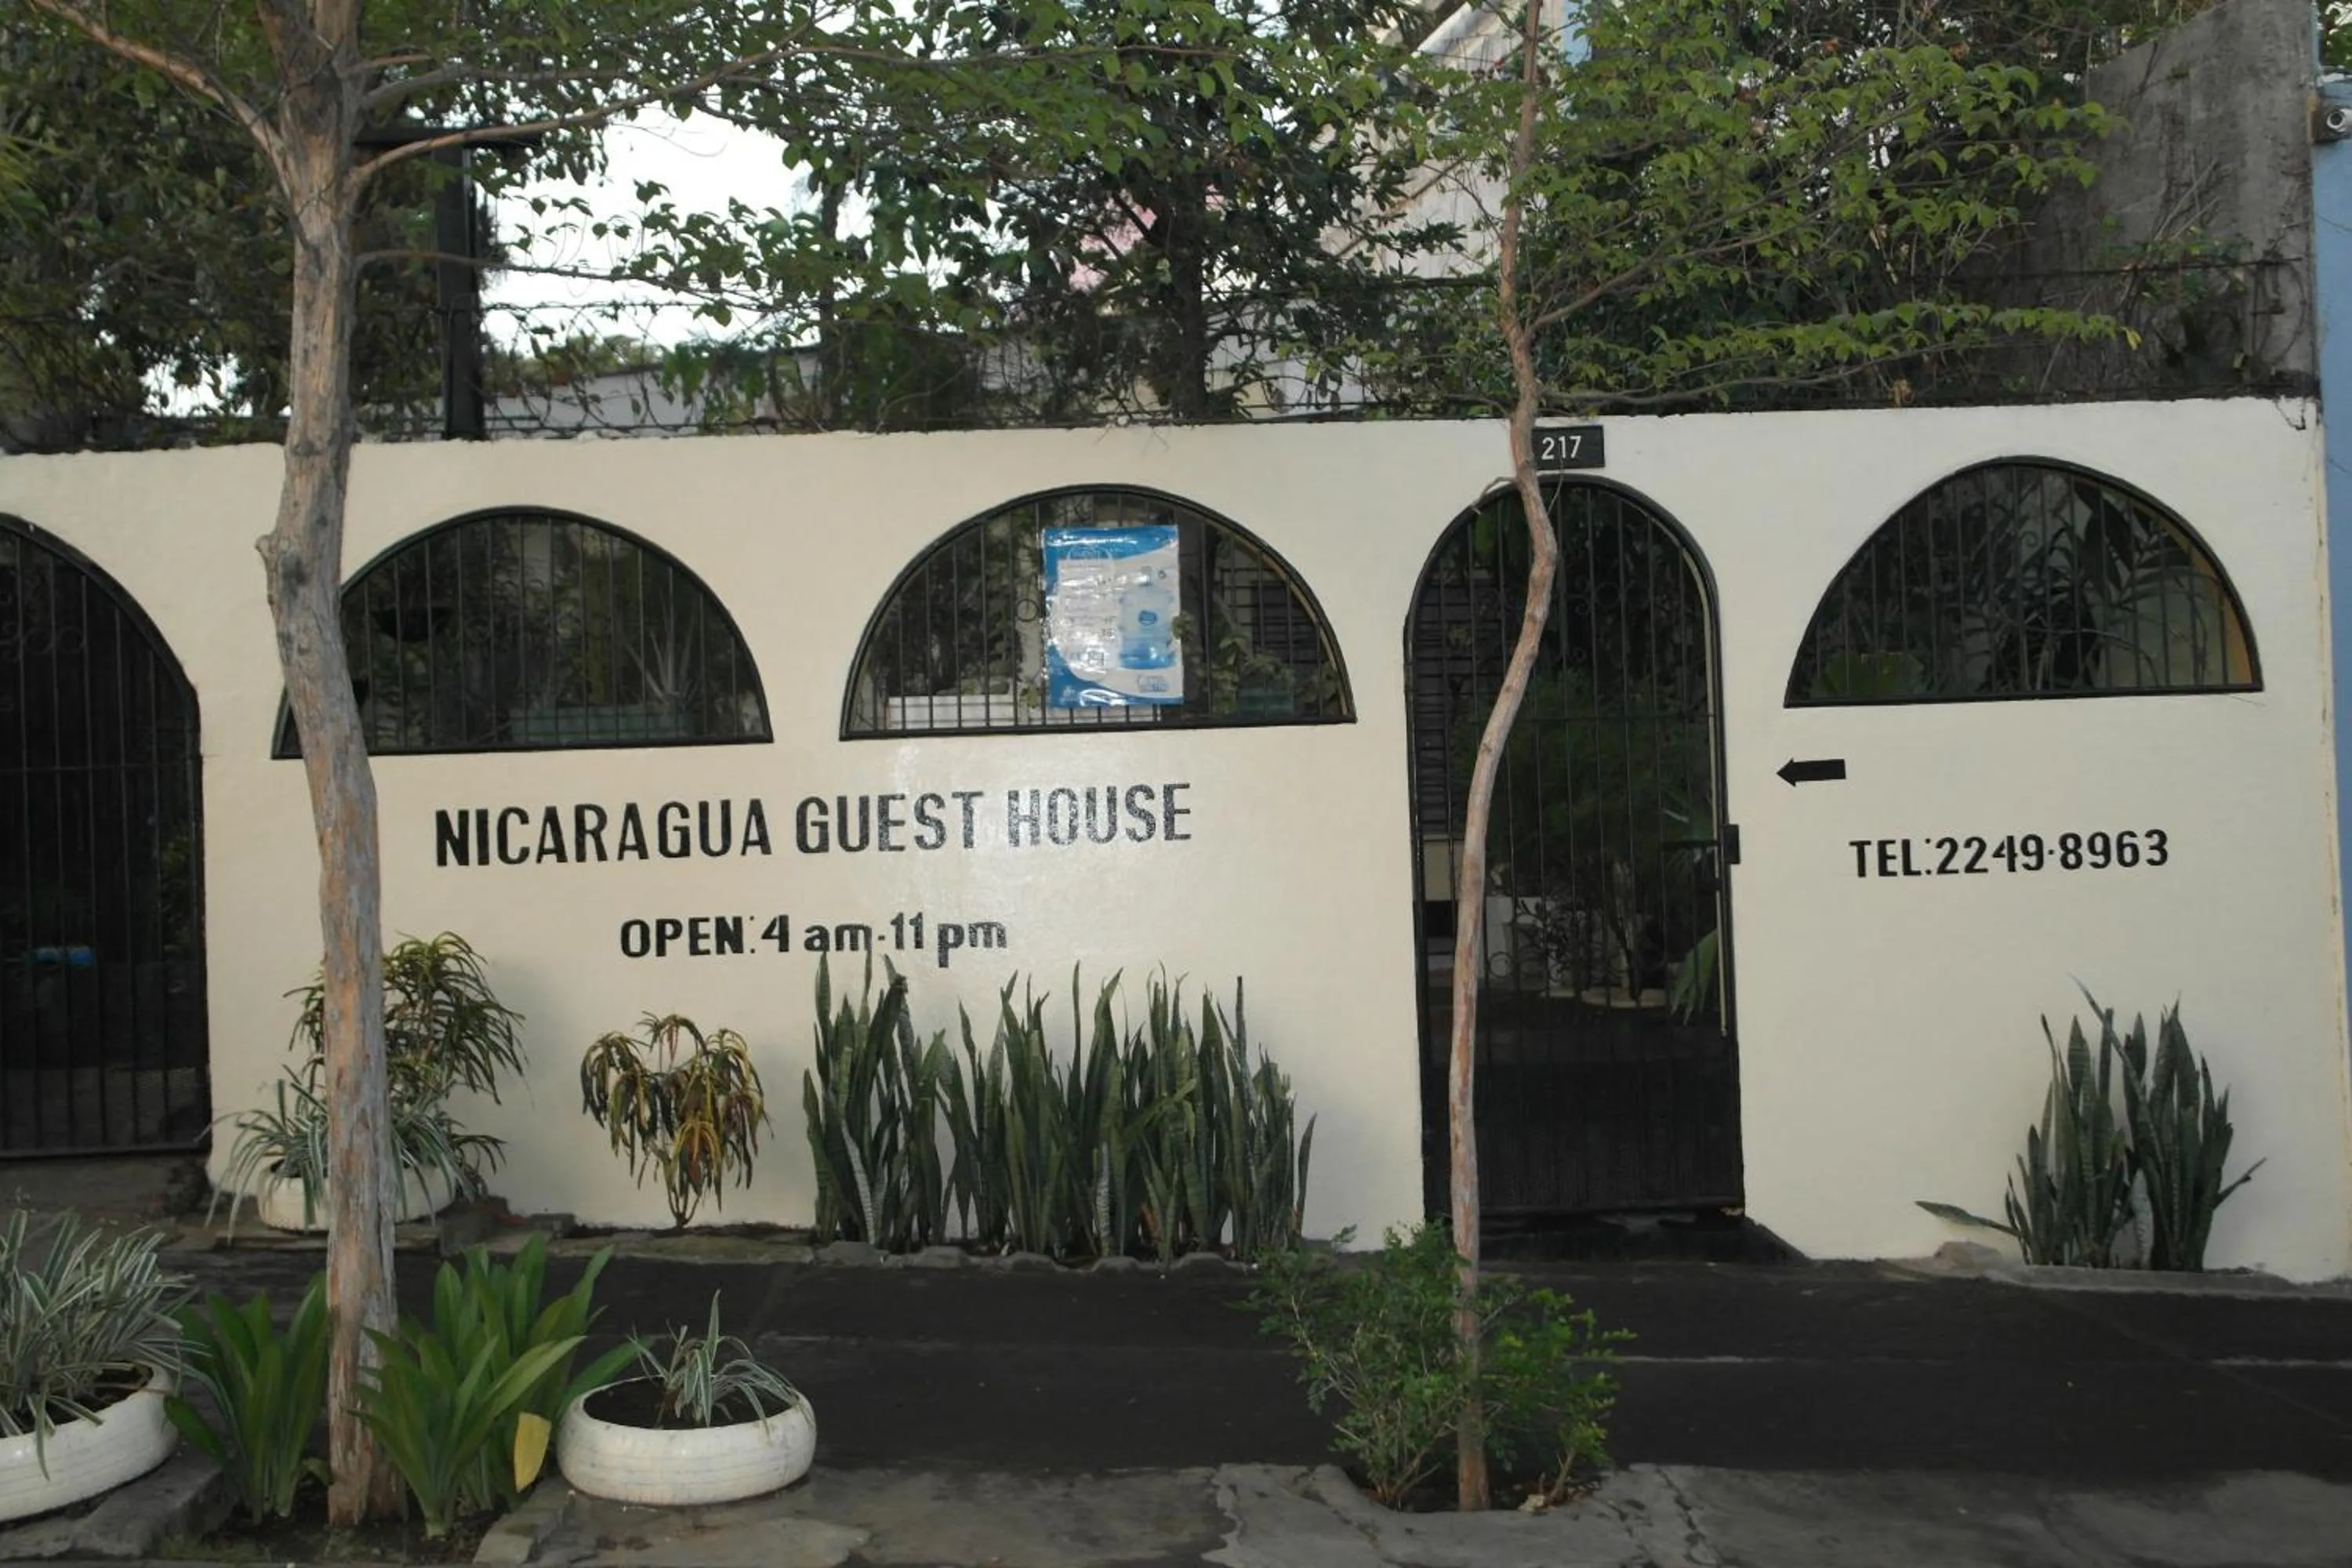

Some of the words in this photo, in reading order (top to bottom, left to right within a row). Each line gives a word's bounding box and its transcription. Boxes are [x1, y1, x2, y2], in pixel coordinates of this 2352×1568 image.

[1541, 434, 1582, 461] 217
[434, 798, 773, 868] NICARAGUA
[795, 790, 985, 854] GUEST
[1007, 782, 1192, 848] HOUSE
[936, 920, 1008, 969] pm
